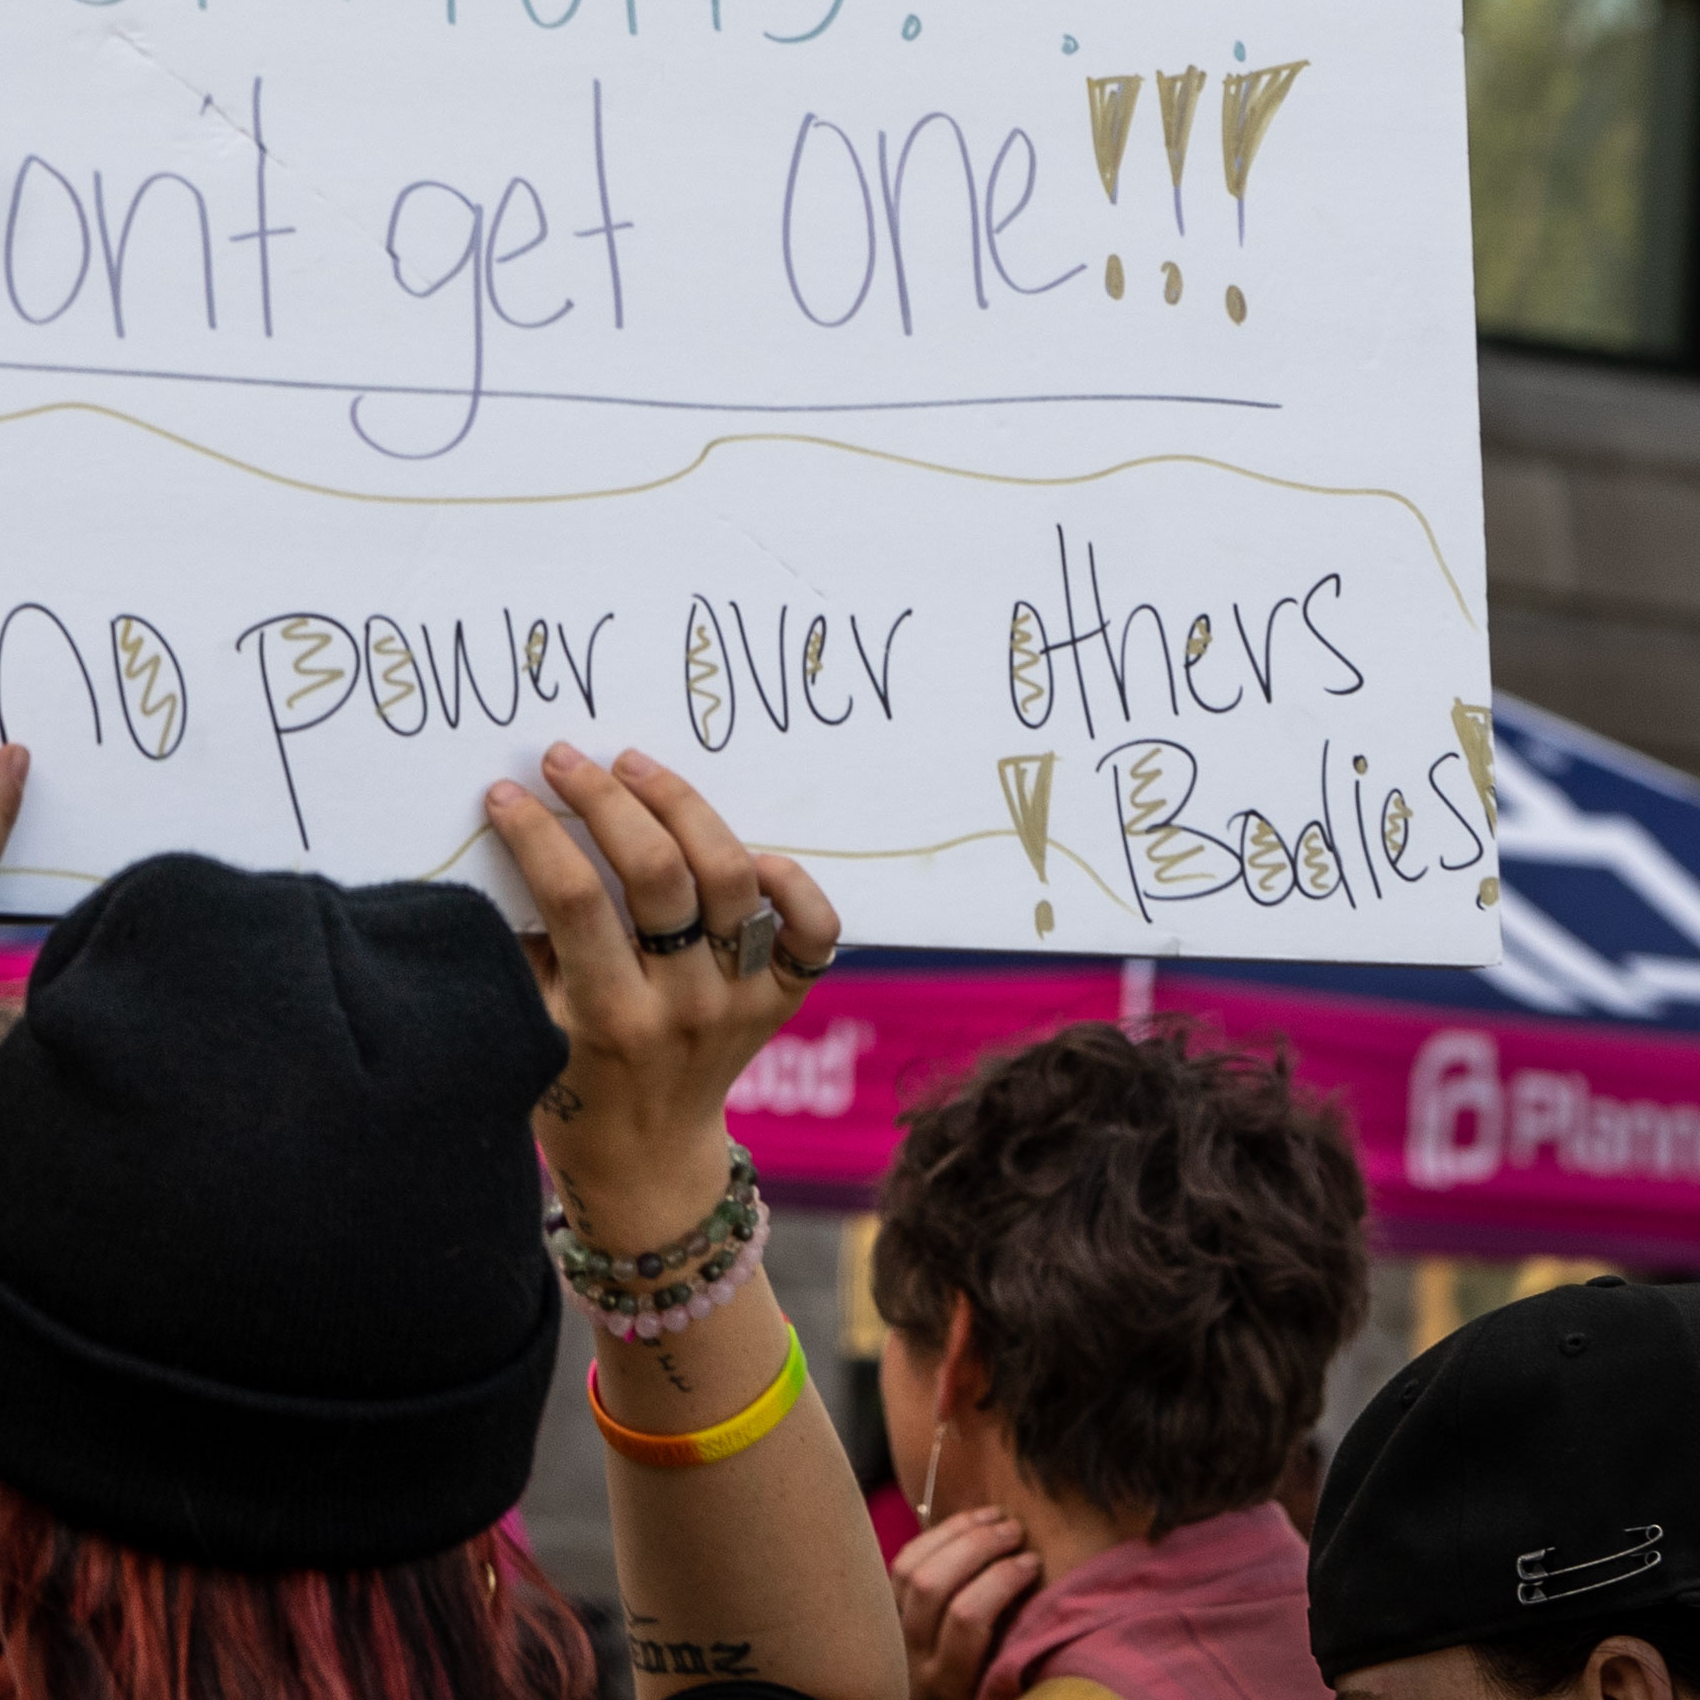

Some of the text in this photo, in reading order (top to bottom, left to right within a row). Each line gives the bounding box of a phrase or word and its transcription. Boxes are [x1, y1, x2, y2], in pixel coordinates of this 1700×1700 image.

[350, 78, 635, 461] get
[236, 605, 616, 853] power
[684, 591, 914, 753] over
[1009, 522, 1365, 741] others
